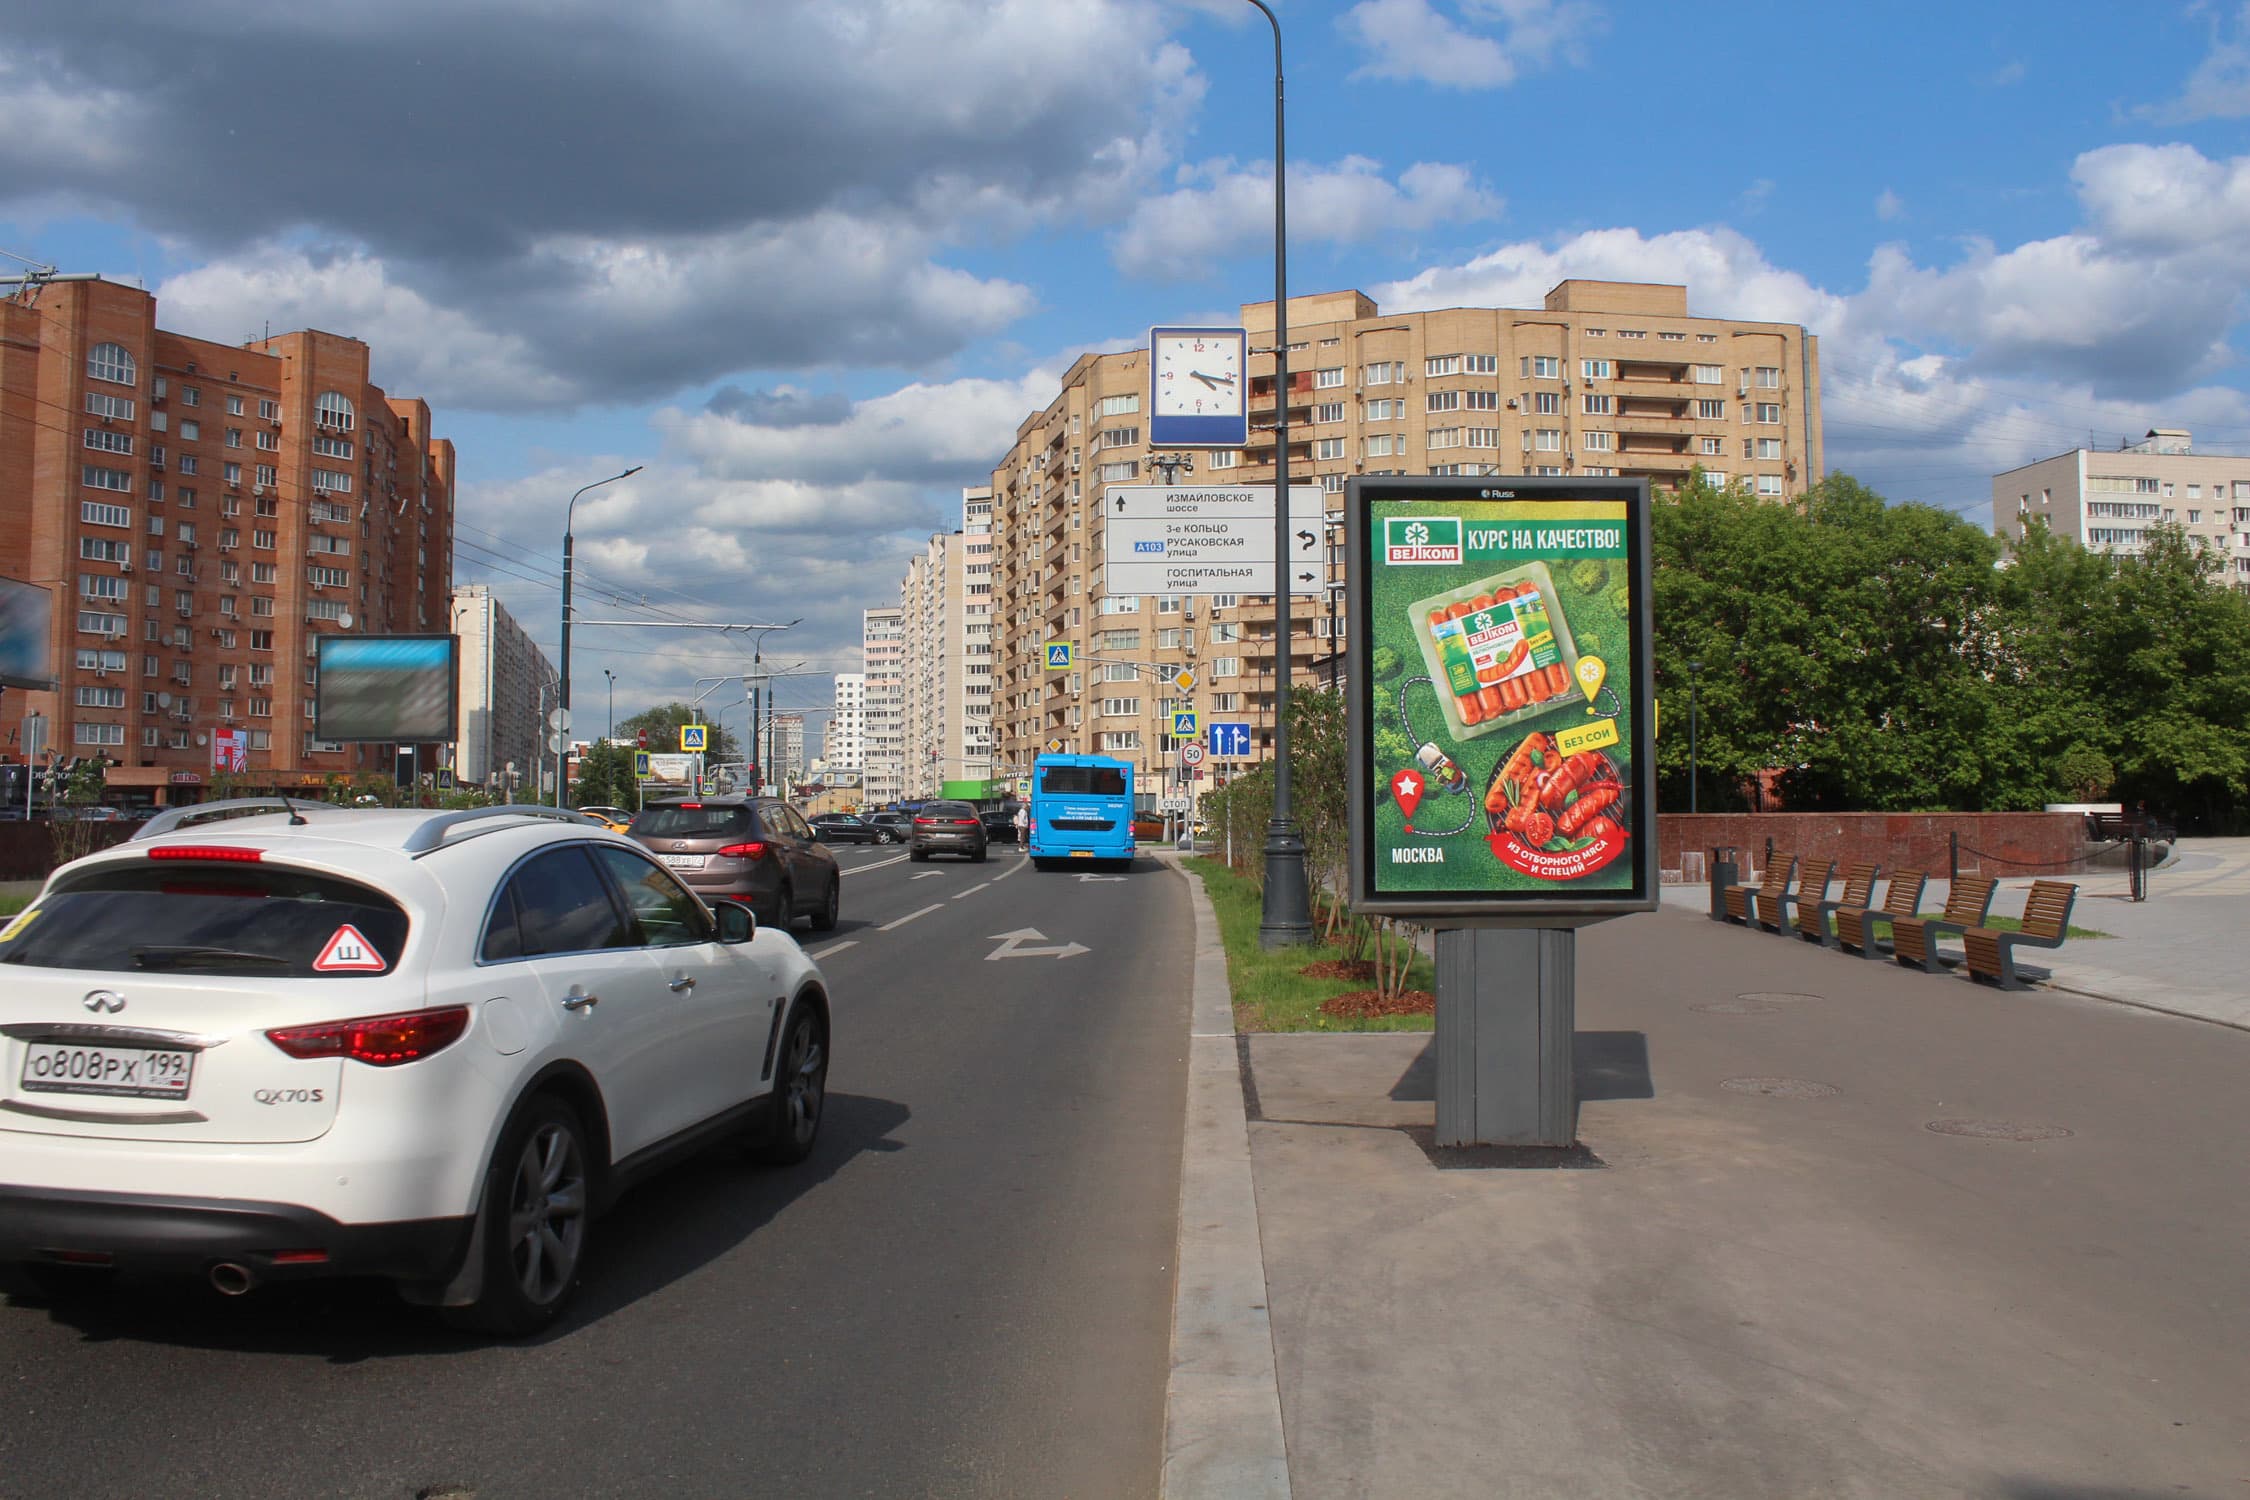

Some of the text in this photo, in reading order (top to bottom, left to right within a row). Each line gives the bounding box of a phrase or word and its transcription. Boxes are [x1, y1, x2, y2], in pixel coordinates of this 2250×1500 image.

[1193, 343, 1205, 353] 12
[1166, 372, 1174, 381] 9
[1224, 372, 1232, 381] 3
[1195, 399, 1202, 408] 6
[1166, 491, 1254, 503] ИЗМАЙЛОВСКОЕ
[1492, 490, 1515, 499] Russ
[1166, 504, 1198, 513] шоссе
[1166, 524, 1228, 535] 3-е КОЛЬЦО
[1167, 537, 1244, 547] РУСАКОВСКАЯ
[1468, 529, 1620, 550] КУРС НА КАЧЕСТВО!
[1167, 548, 1198, 558] улица
[1392, 547, 1456, 560] ВЕЛКОМ
[1167, 568, 1253, 577] ГОСПИТАЛЬНАЯ
[1167, 579, 1198, 588] улица
[1470, 622, 1517, 645] ВЕЛКОМ
[1564, 729, 1610, 749] БЕЗ СОИ
[1186, 750, 1200, 759] 50
[1163, 800, 1187, 809] СТОП
[1391, 847, 1444, 864] МОСКВА
[1507, 840, 1608, 866] ИЗ ОТБОРНОГО МЯСА
[1531, 862, 1585, 876] И СПЕЦИЙ
[338, 945, 361, 961] Ш
[145, 1053, 184, 1075] 199
